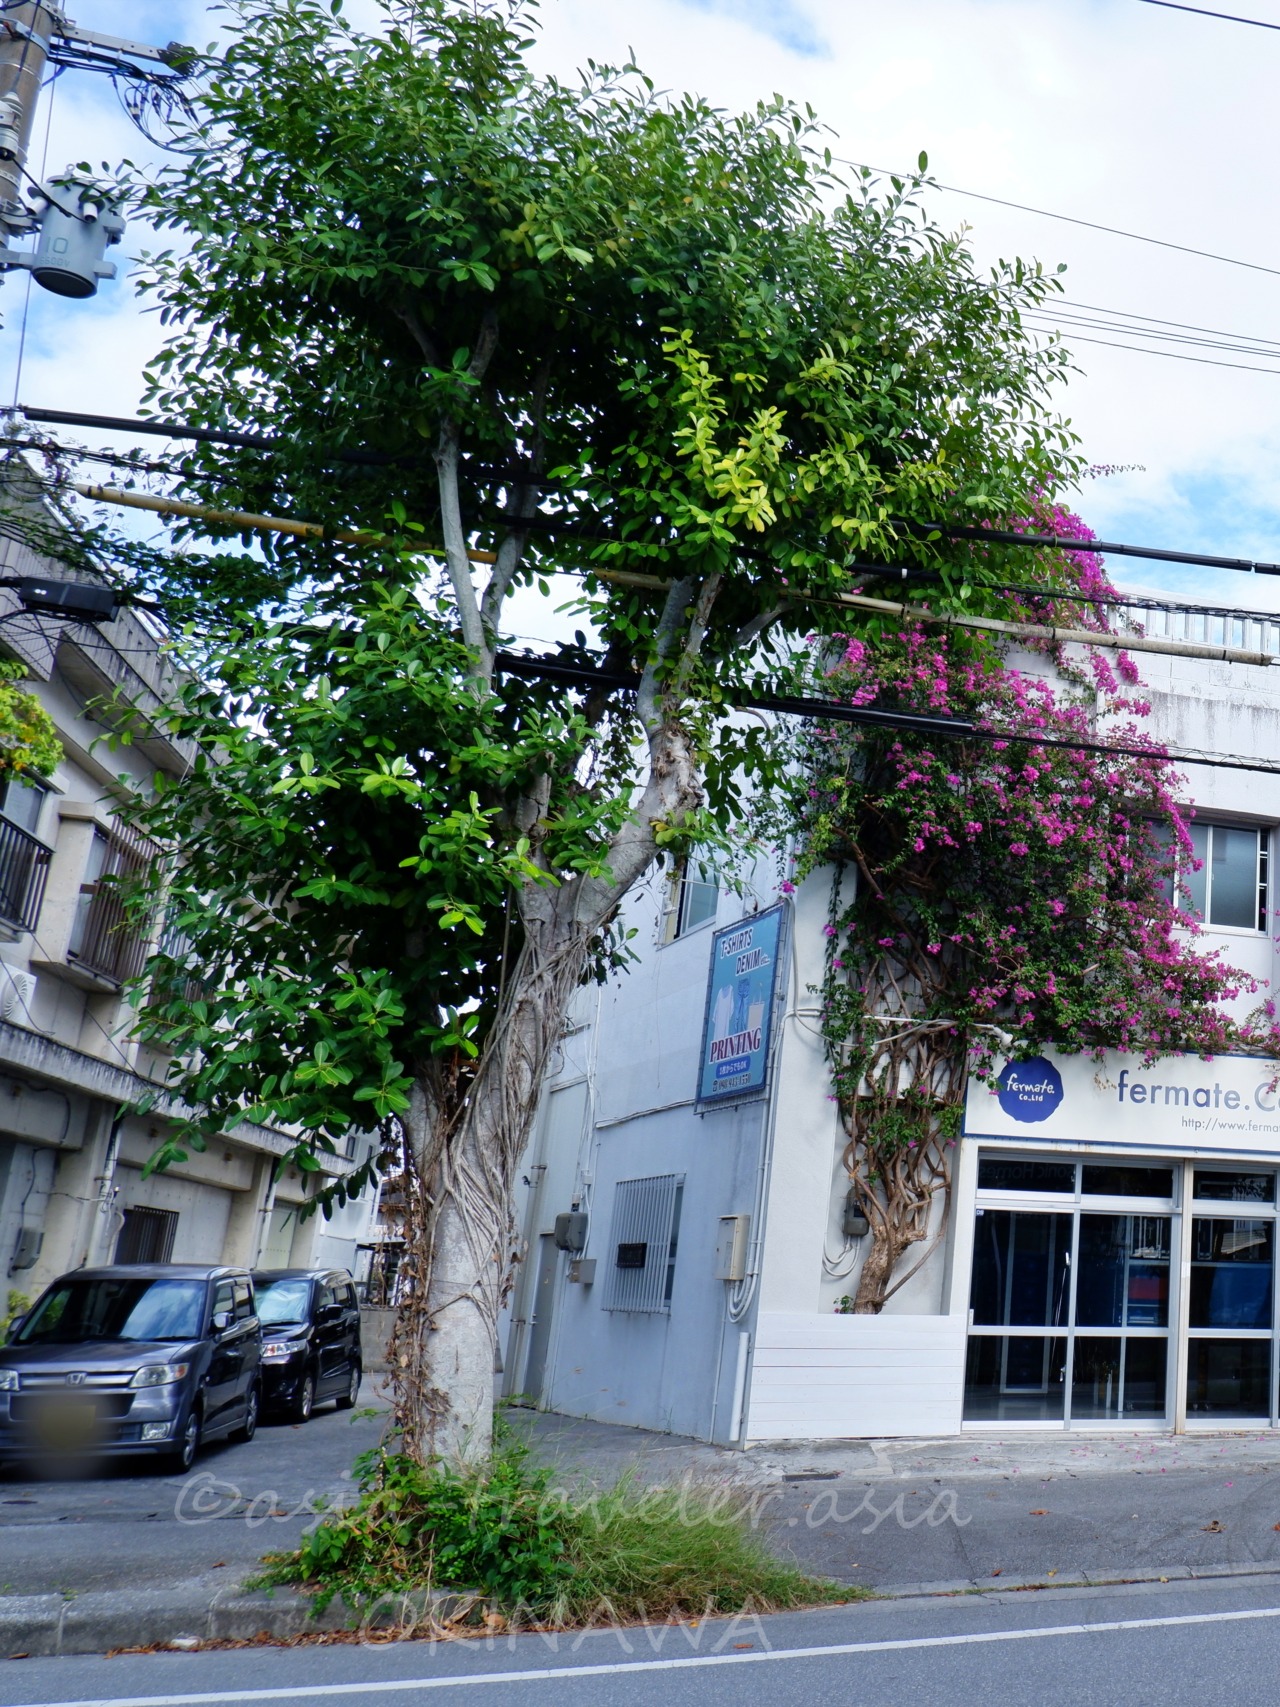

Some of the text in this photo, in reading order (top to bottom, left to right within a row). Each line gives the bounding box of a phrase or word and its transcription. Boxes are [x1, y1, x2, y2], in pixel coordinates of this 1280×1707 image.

[721, 928, 752, 957] T-SHIRTS
[736, 949, 761, 975] DENIM
[710, 1028, 761, 1062] PRINTING
